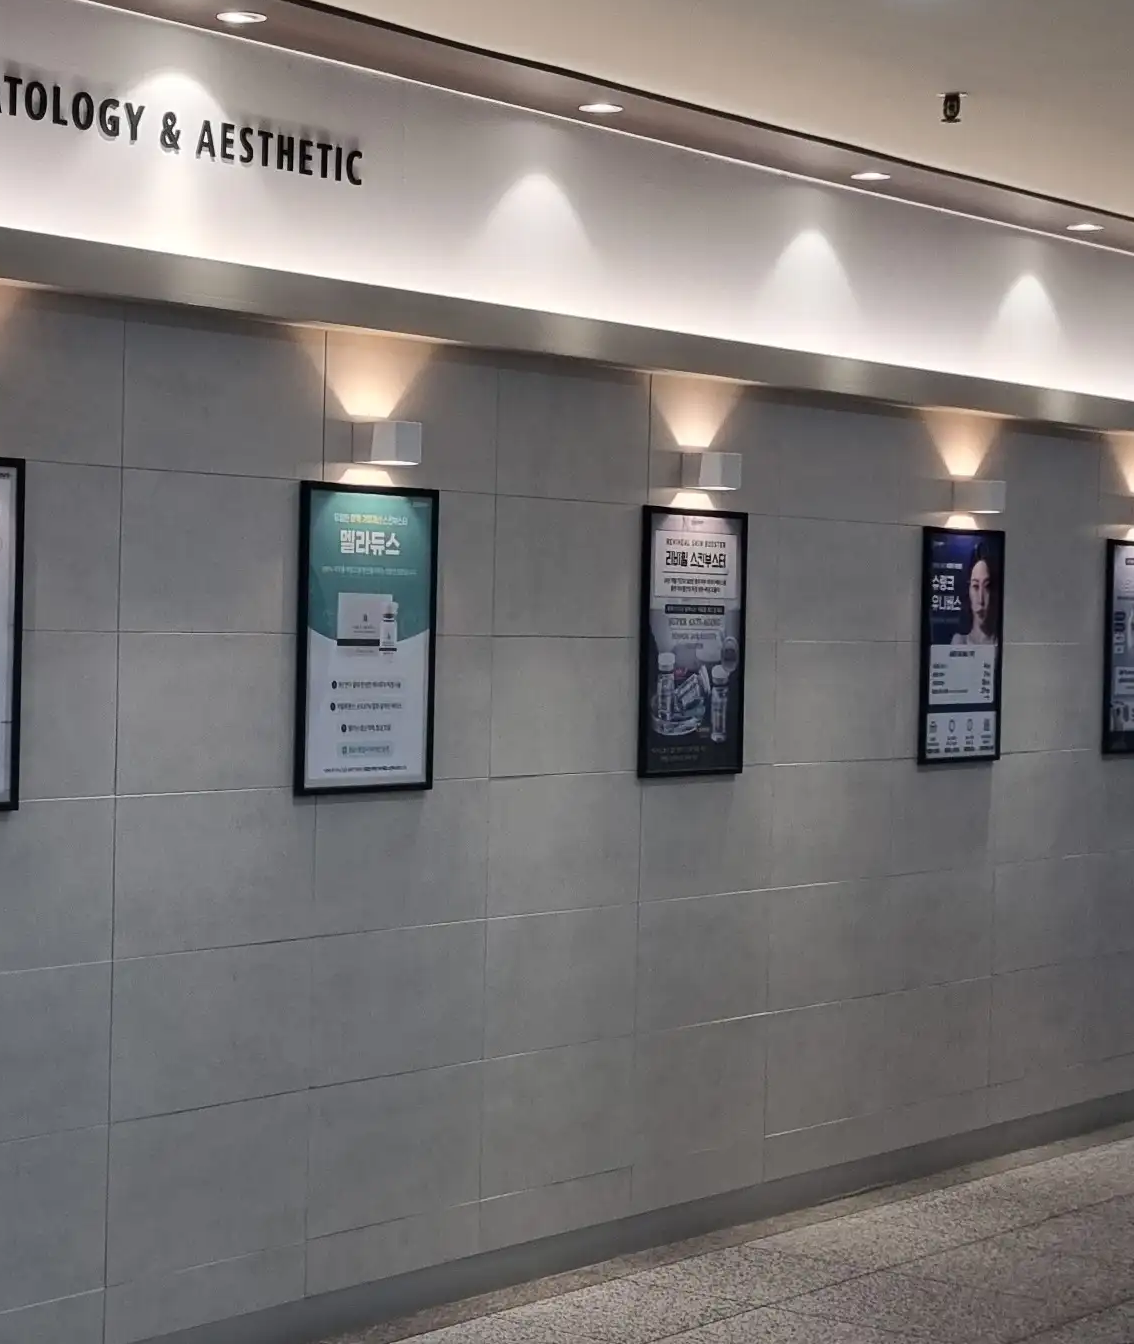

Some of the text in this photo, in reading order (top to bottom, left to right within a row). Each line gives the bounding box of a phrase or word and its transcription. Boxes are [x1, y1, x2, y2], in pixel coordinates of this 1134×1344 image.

[160, 111, 181, 151] &
[196, 120, 363, 186] AESTHETIC
[340, 529, 400, 556] 멜라듀스
